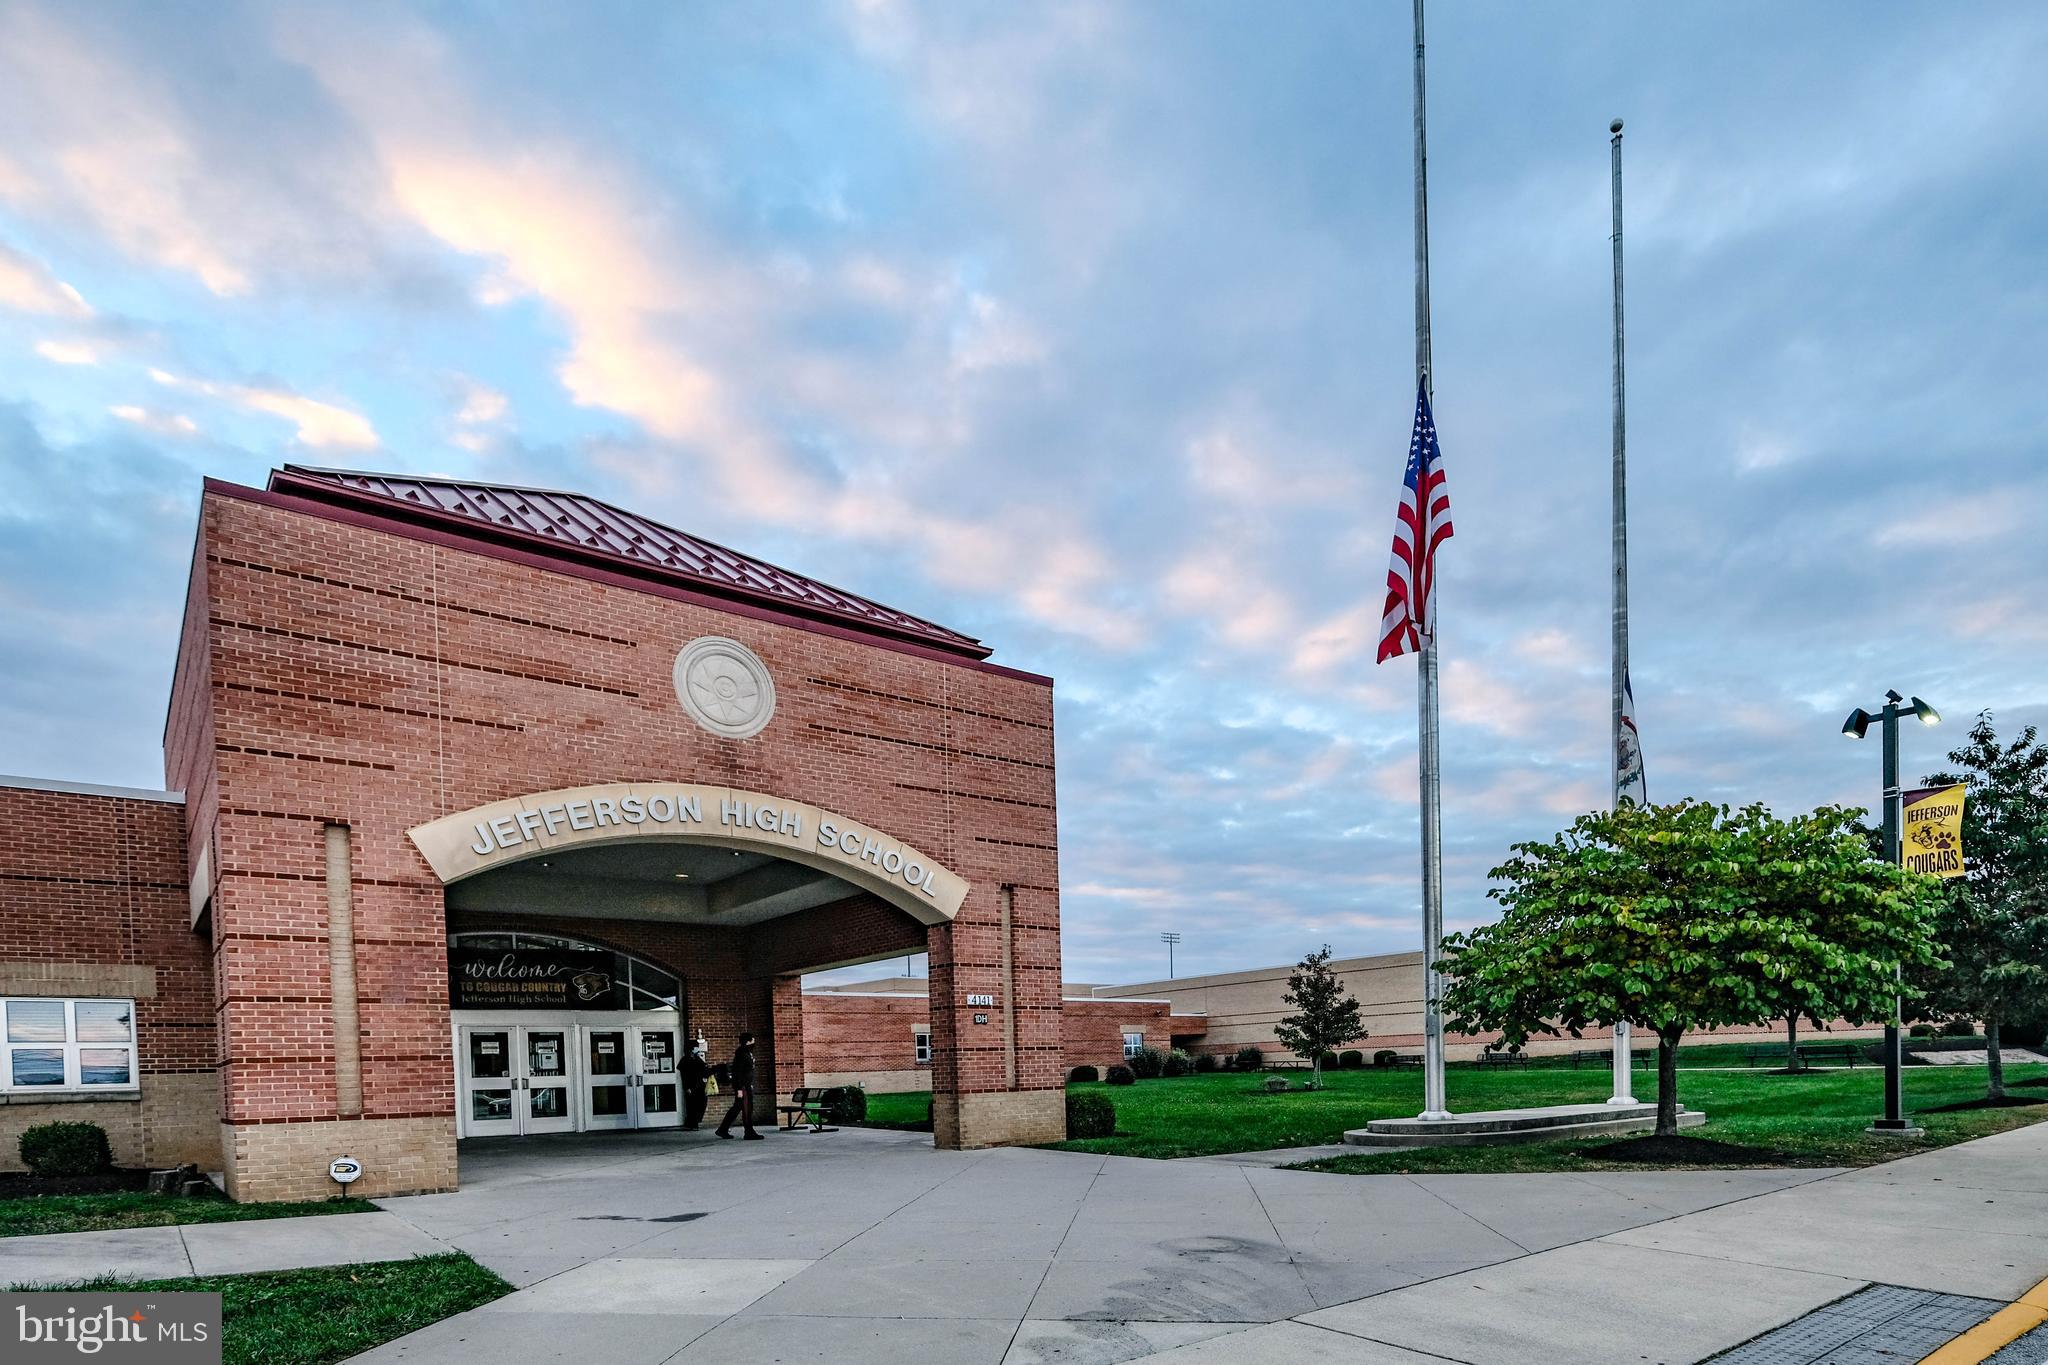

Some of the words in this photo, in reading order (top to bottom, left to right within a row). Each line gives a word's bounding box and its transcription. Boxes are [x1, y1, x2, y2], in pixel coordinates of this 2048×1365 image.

[1907, 804, 1959, 824] JEFFERSON
[471, 794, 702, 856] JEFFERSON
[720, 799, 802, 838] HIGH
[816, 821, 937, 898] SCHOOL
[1906, 849, 1959, 875] COUGARS
[460, 982, 474, 992] TO
[475, 982, 519, 993] COUGAR
[521, 982, 567, 993] COUNTRY
[461, 994, 506, 1003] Jefferson
[508, 994, 532, 1005] High
[534, 994, 567, 1003] School
[971, 995, 991, 1005] 4141
